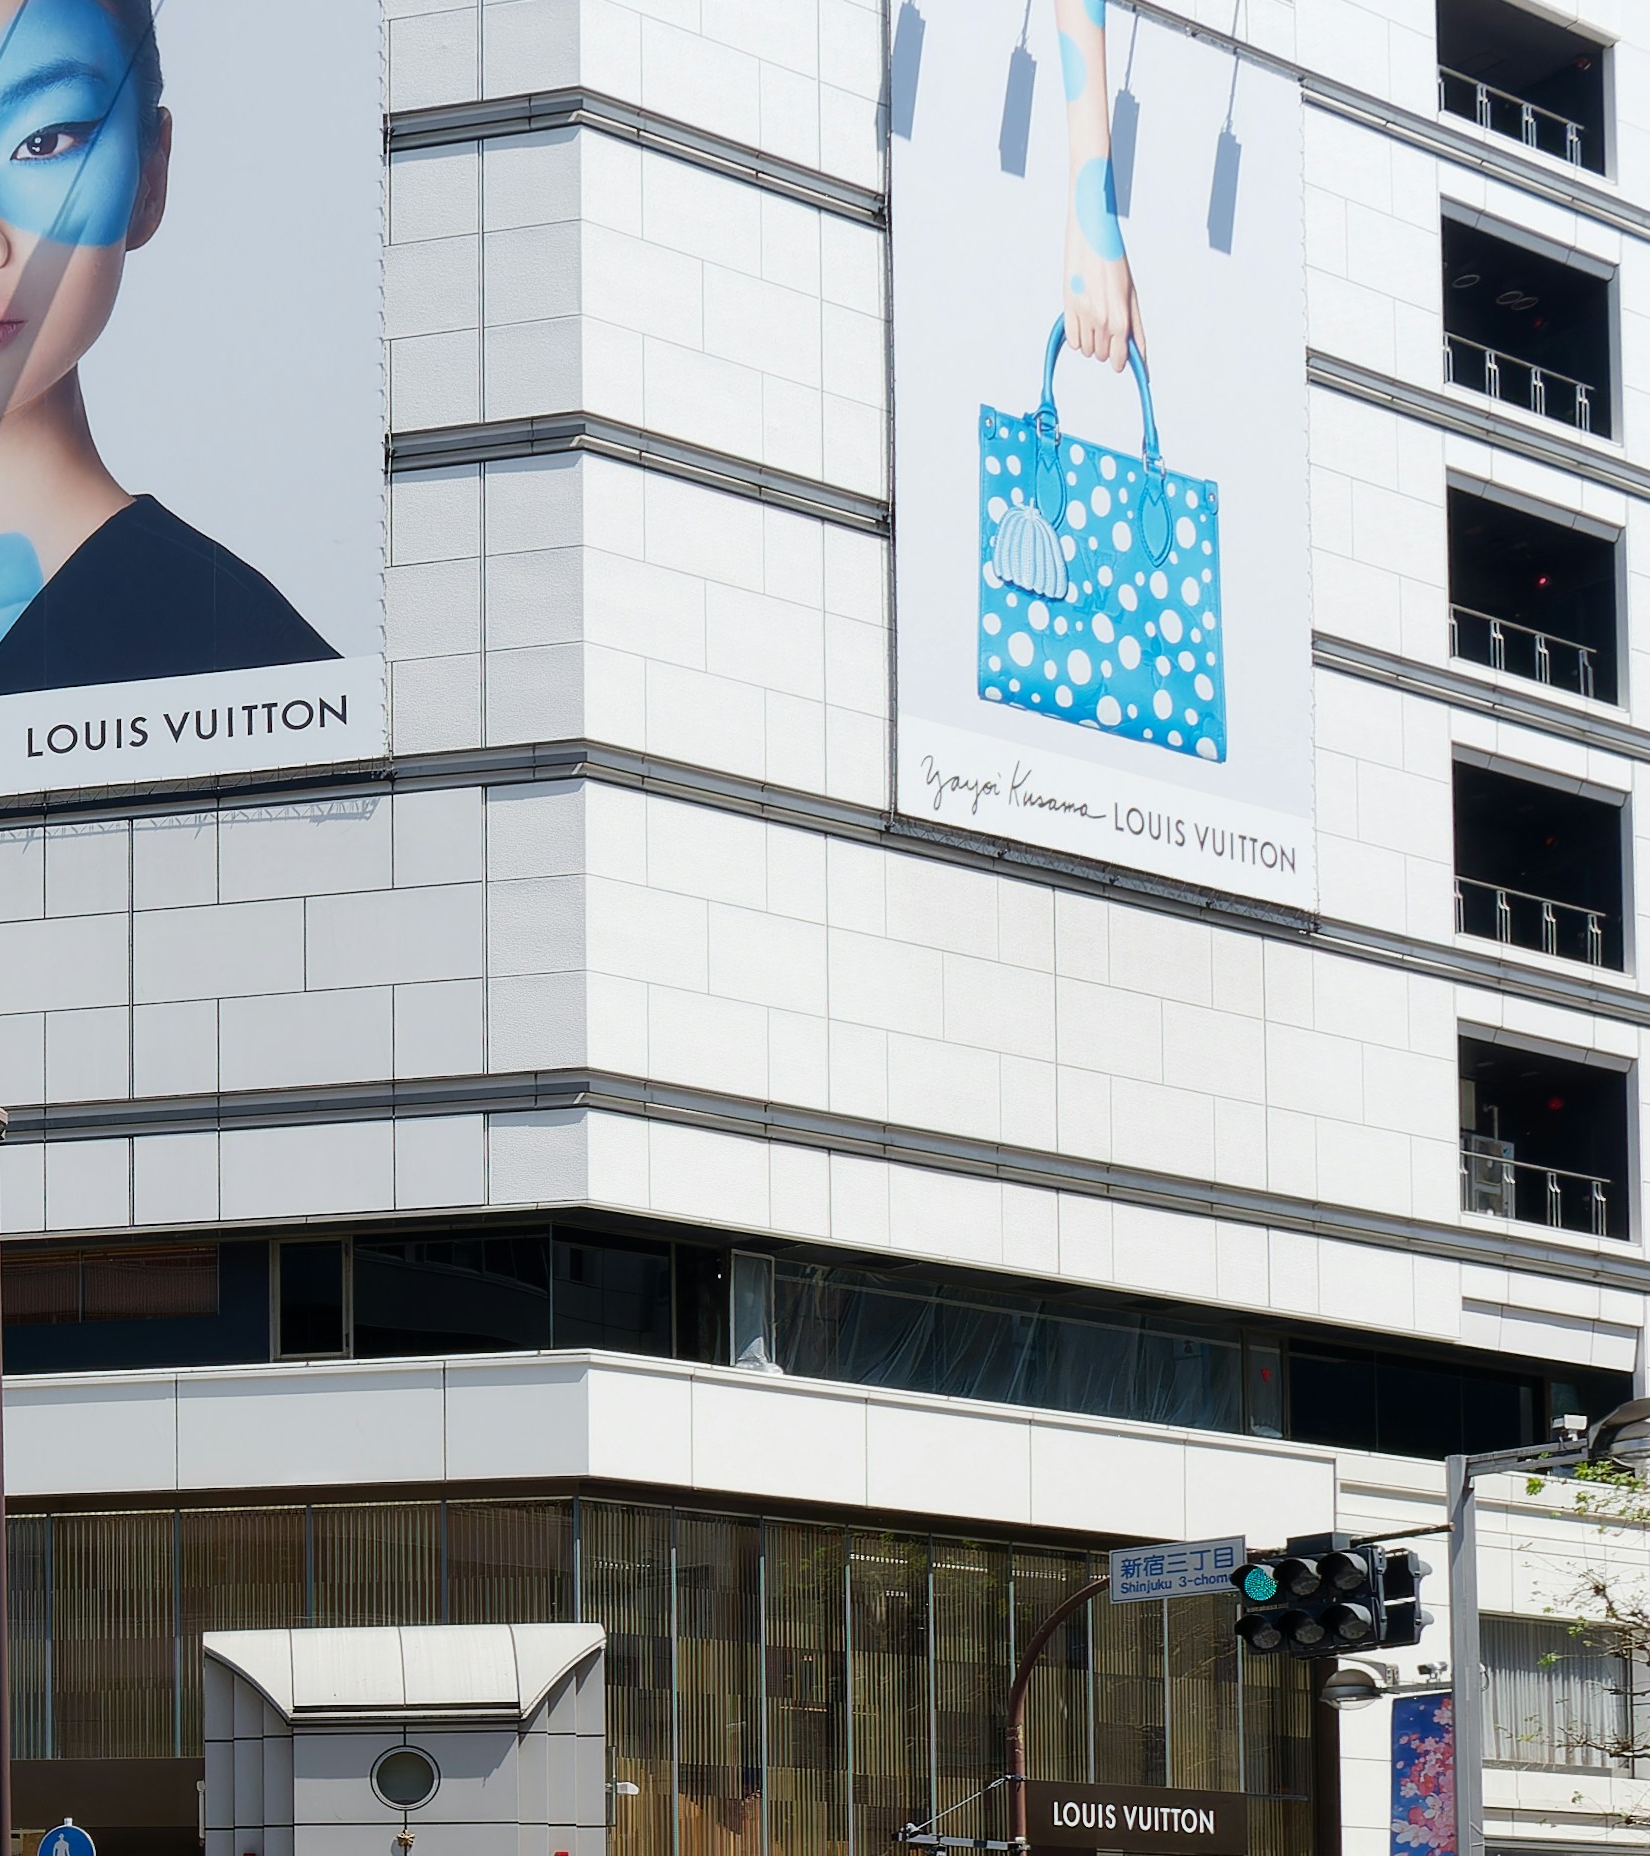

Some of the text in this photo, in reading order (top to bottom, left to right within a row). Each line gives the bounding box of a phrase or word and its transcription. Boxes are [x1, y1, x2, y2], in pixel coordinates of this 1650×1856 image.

[26, 694, 348, 758] LOUIS VUITTON
[1008, 760, 1107, 820] Kusama
[1114, 802, 1297, 874] LOUIS VUITTON
[1120, 1546, 1234, 1580] 新宿三丁目
[1120, 1579, 1172, 1594] Shinjuku
[1052, 1801, 1216, 1835] LOUIS VUITTON
